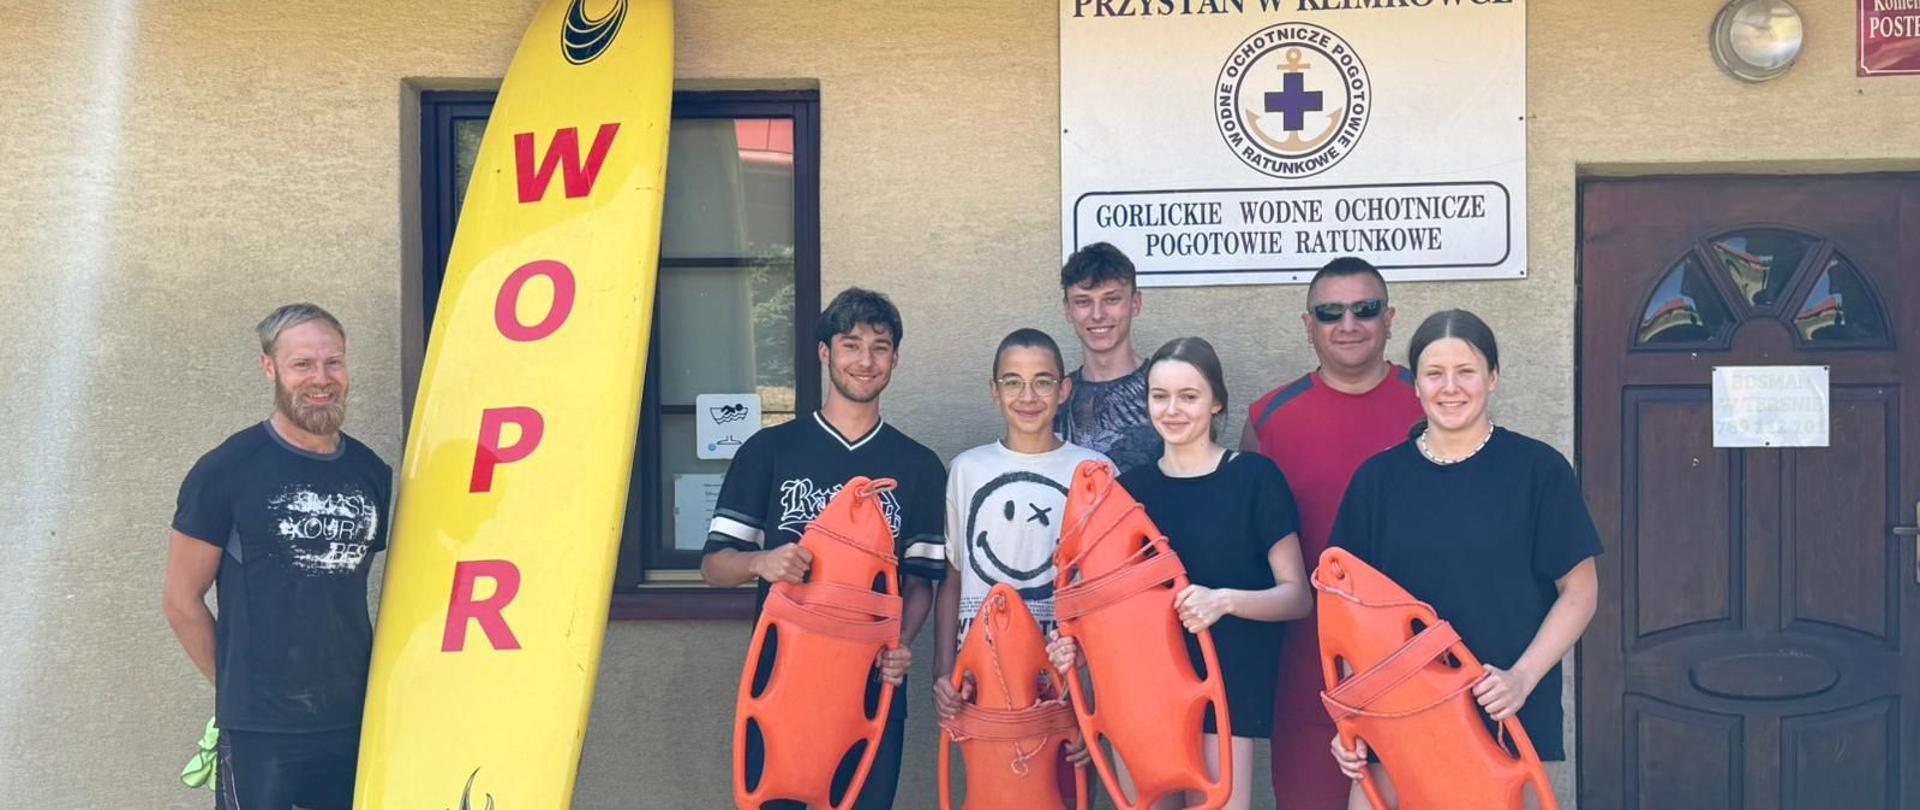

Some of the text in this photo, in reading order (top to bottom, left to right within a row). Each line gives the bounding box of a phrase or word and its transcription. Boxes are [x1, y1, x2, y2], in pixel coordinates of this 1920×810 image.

[1219, 27, 1366, 149] WODNE OCHOTNICZE POGOTOWIE
[1241, 146, 1340, 174] RATUNKOWE
[1096, 195, 1485, 228] GORLICKIE WODNE OCHOTNICZE
[1145, 227, 1442, 257] POGOTOWIE RATUNKOWE
